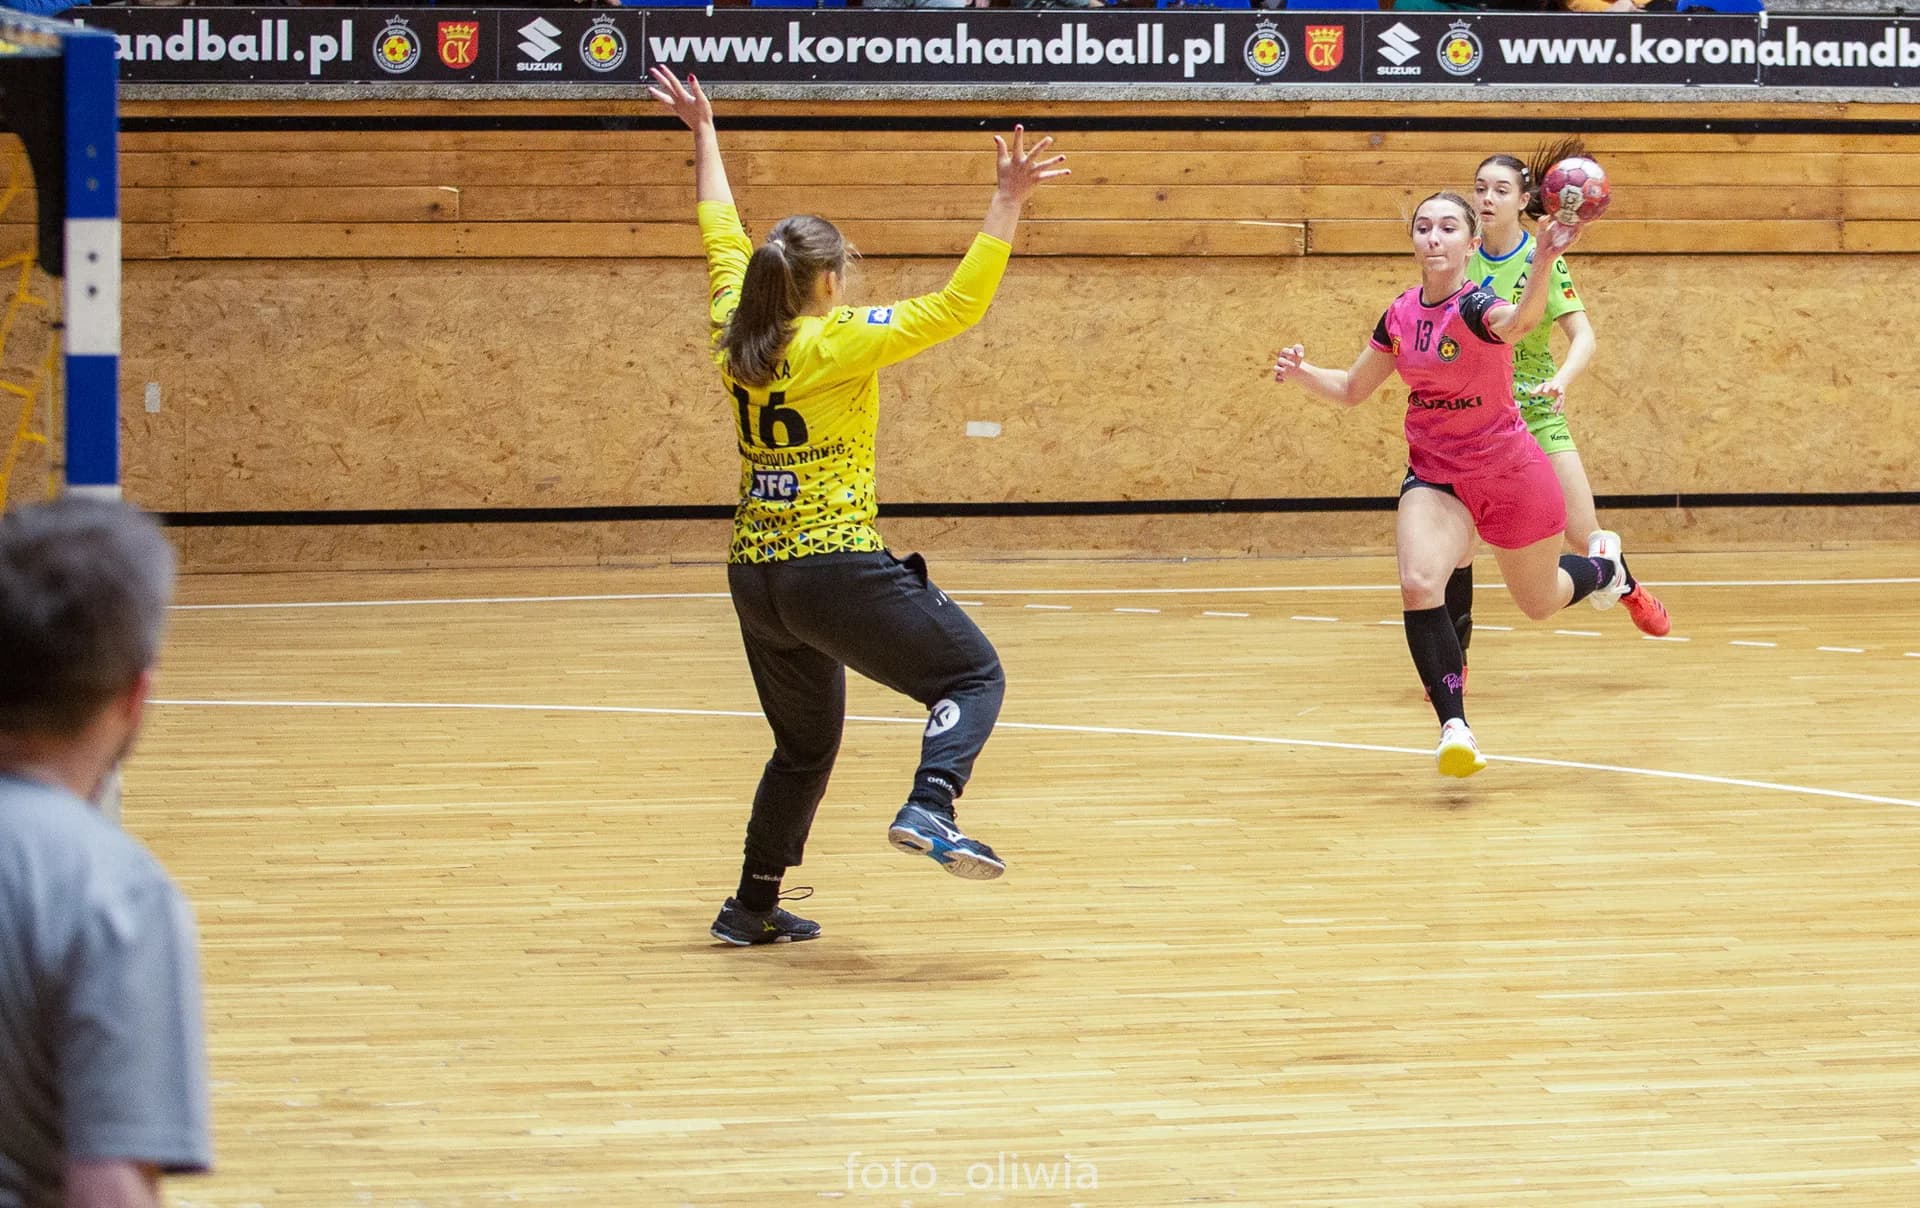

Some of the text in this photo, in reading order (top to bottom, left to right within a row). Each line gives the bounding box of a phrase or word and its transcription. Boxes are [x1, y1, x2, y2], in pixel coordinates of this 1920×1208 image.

[113, 19, 353, 75] andball.pl
[442, 41, 470, 63] CK
[649, 22, 1225, 77] www.koronahandball.pl
[1309, 44, 1337, 66] CK
[516, 62, 562, 71] SUZUKI
[1377, 66, 1422, 75] SUZUKI
[1414, 319, 1434, 352] 13
[732, 382, 809, 449] 16
